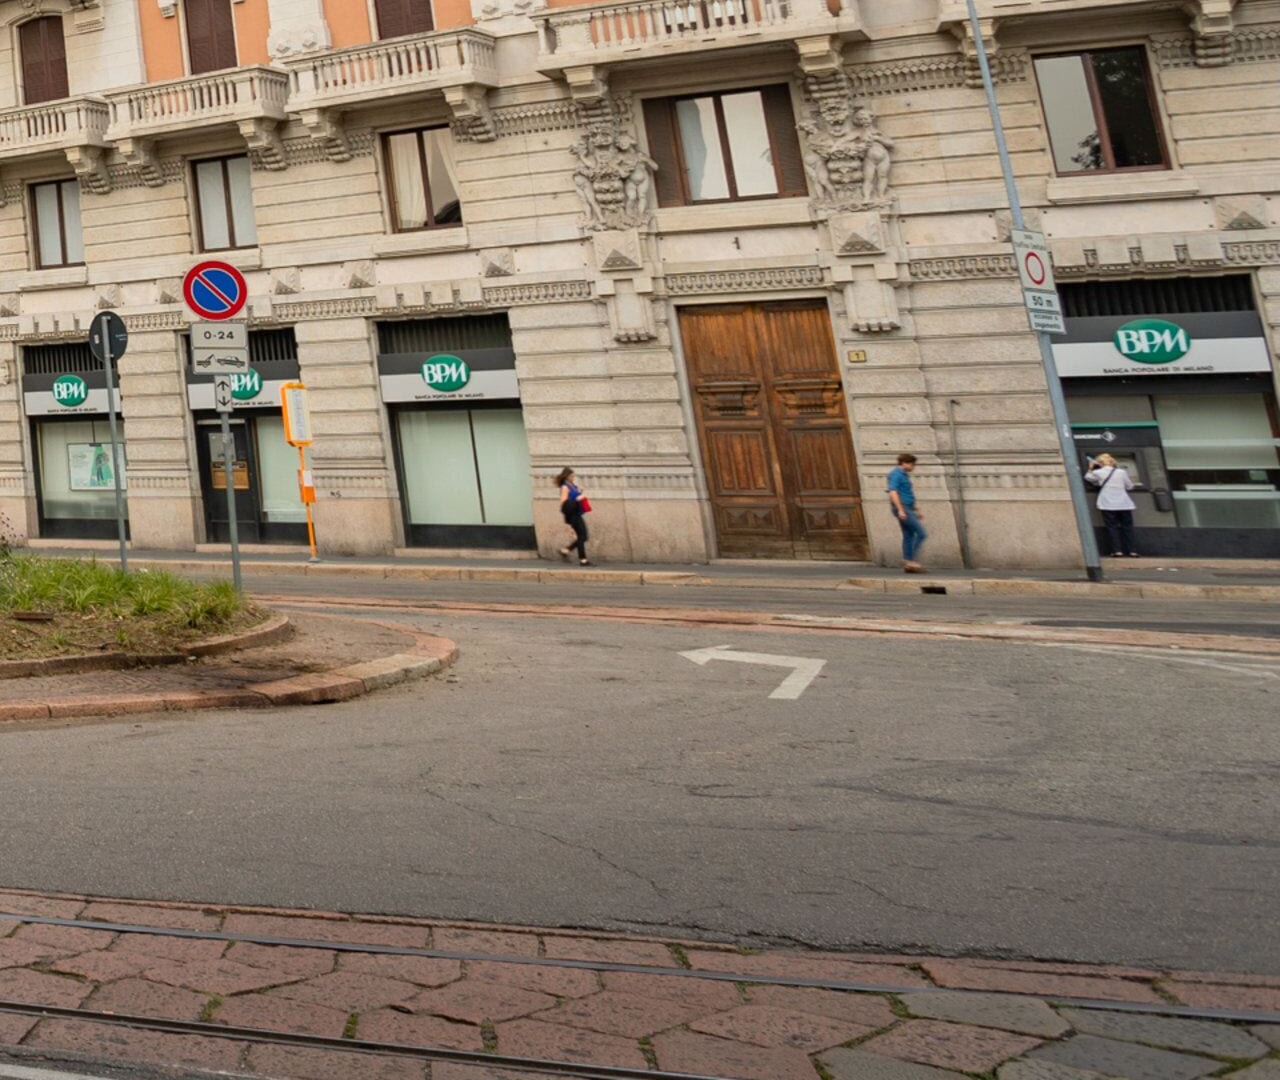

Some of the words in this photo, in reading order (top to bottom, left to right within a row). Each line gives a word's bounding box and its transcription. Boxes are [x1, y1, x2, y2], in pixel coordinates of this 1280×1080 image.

[731, 236, 741, 250] 1
[1032, 295, 1044, 306] 50
[1045, 299, 1054, 307] m
[203, 330, 234, 340] 0-24
[1116, 328, 1188, 354] BPM
[422, 361, 467, 384] BPM
[53, 381, 86, 400] BPM
